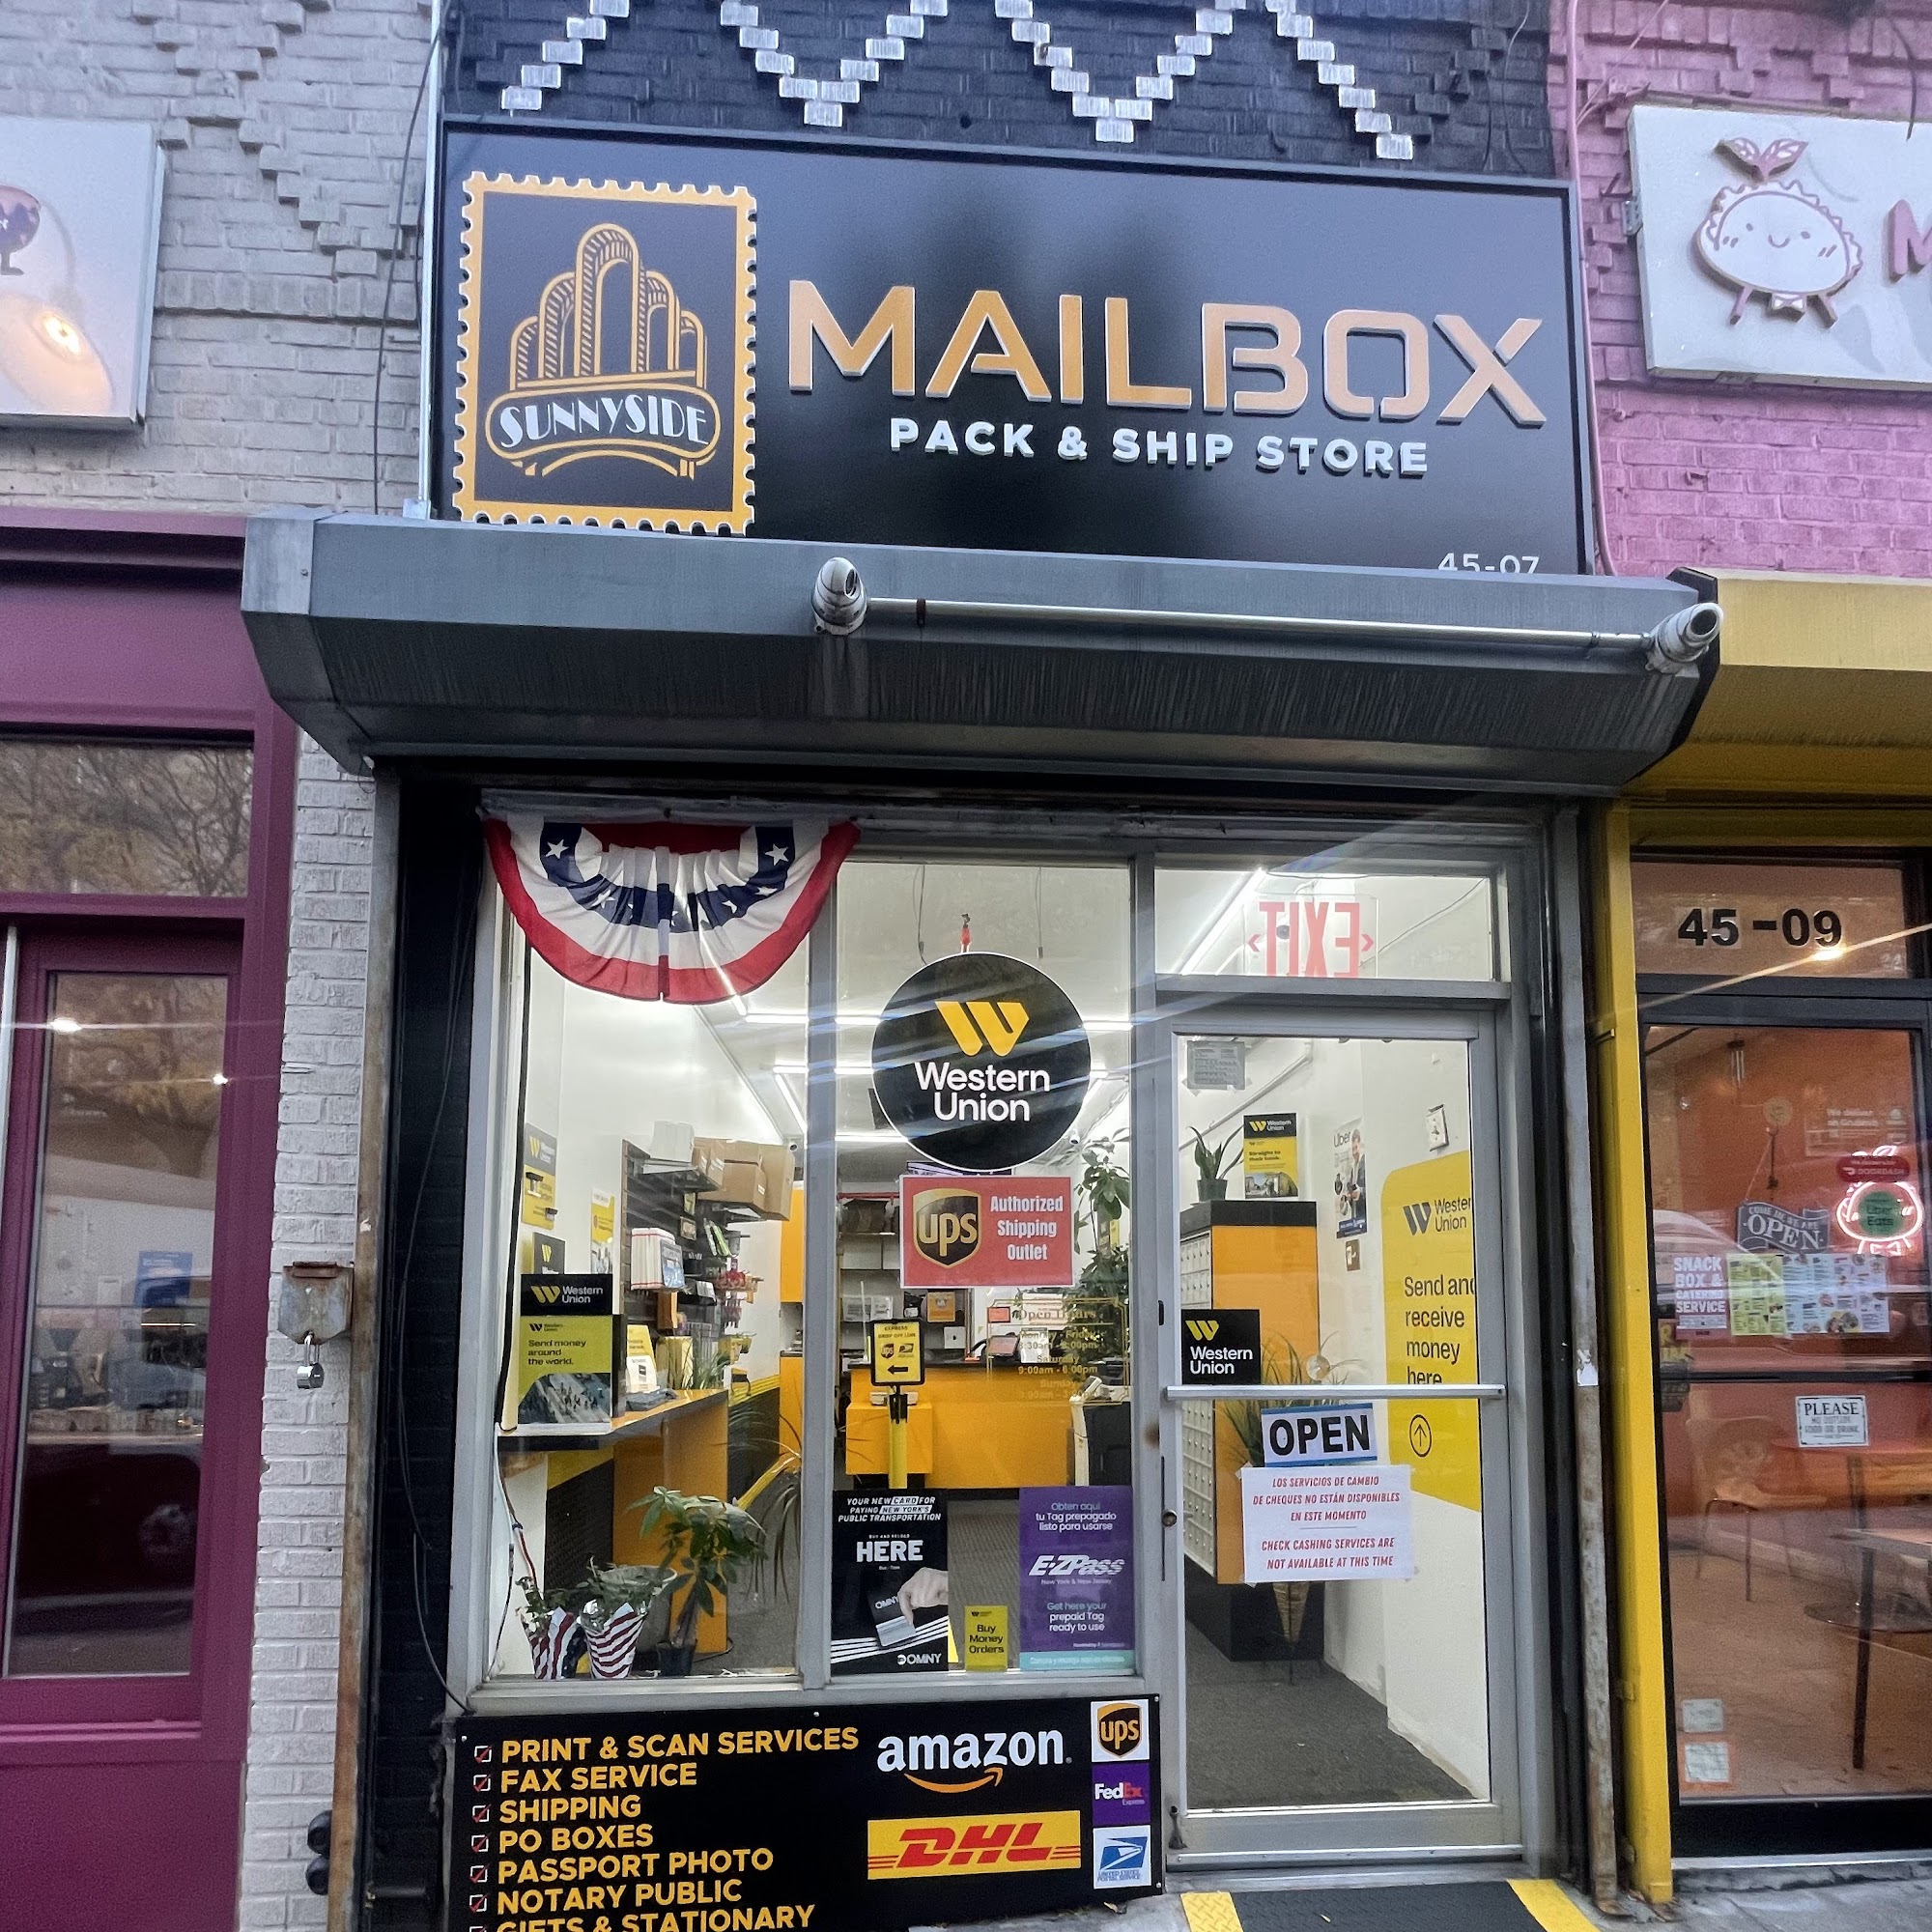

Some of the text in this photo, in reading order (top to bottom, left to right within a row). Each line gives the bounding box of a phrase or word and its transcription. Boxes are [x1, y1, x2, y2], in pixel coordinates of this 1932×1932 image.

[788, 279, 1547, 426] MAILBOX
[499, 394, 709, 448] SUNNYSIDE
[890, 417, 1428, 475] PACK & SHIP STORE
[1437, 553, 1540, 575] 45-07
[914, 1062, 1051, 1092] Western
[934, 1092, 1031, 1122] Union
[1333, 1131, 1351, 1148] Uber
[990, 1195, 1064, 1212] Authorized
[997, 1218, 1057, 1238] Shipping
[1435, 1215, 1466, 1233] Union
[1747, 1213, 1821, 1250] OPEN
[917, 1213, 977, 1257] ups
[1007, 1243, 1047, 1260] Outlet
[1673, 1257, 1722, 1271] SNACK
[1405, 1274, 1443, 1296] Send
[1675, 1273, 1722, 1288] BOX &
[561, 1294, 591, 1303] Union
[562, 1286, 604, 1295] Western
[1676, 1300, 1726, 1313] SERVICE
[1406, 1306, 1465, 1328] receive
[1190, 1346, 1253, 1360] Western
[1406, 1341, 1461, 1365] money
[1190, 1360, 1235, 1375] Union
[1407, 1366, 1442, 1384] here
[1804, 1402, 1860, 1416] PLEASE
[1269, 1415, 1370, 1456] OPEN
[1272, 1476, 1378, 1488] LOS SERVICIOS DE CAMBIO
[1253, 1492, 1400, 1505] DE CHEQUES NO ESTÁN DISPONIBLES
[869, 1513, 941, 1522] TRANSPORTATION
[1047, 1513, 1064, 1522] Tag
[1065, 1512, 1117, 1522] prepagado
[1291, 1510, 1367, 1521] EN ESTE MOMENTO
[1038, 1522, 1113, 1533] listo para usarse
[856, 1540, 923, 1562] HERE
[1262, 1537, 1395, 1551] CHECK CASHING SERVICES ARE
[1266, 1555, 1394, 1570] NOT AVAILABLE AT THIS TIME
[1065, 1602, 1086, 1610] here
[1087, 1603, 1107, 1612] your
[1049, 1611, 1105, 1624] prepaid Tag
[977, 1624, 996, 1634] Buy
[1049, 1623, 1105, 1634] ready to use
[969, 1634, 1004, 1644] Money
[906, 1653, 942, 1664] OMNY
[968, 1645, 1005, 1654] Orders
[1100, 1719, 1140, 1749] ups
[501, 1726, 859, 1763] PRINT & SCAN SERVICES
[876, 1729, 1064, 1773] amazon
[500, 1763, 697, 1793] FAX SERVICE
[1094, 1781, 1143, 1800] FedEx
[499, 1795, 641, 1824] SHIPPING
[498, 1823, 653, 1854] PO BOXES
[895, 1823, 1053, 1868] DHL
[498, 1847, 774, 1884] PASSPORT PHOTO
[497, 1879, 743, 1915] NOTARY PUBLIC
[594, 1916, 612, 1932] &
[621, 1904, 815, 1932] STATIONARY
